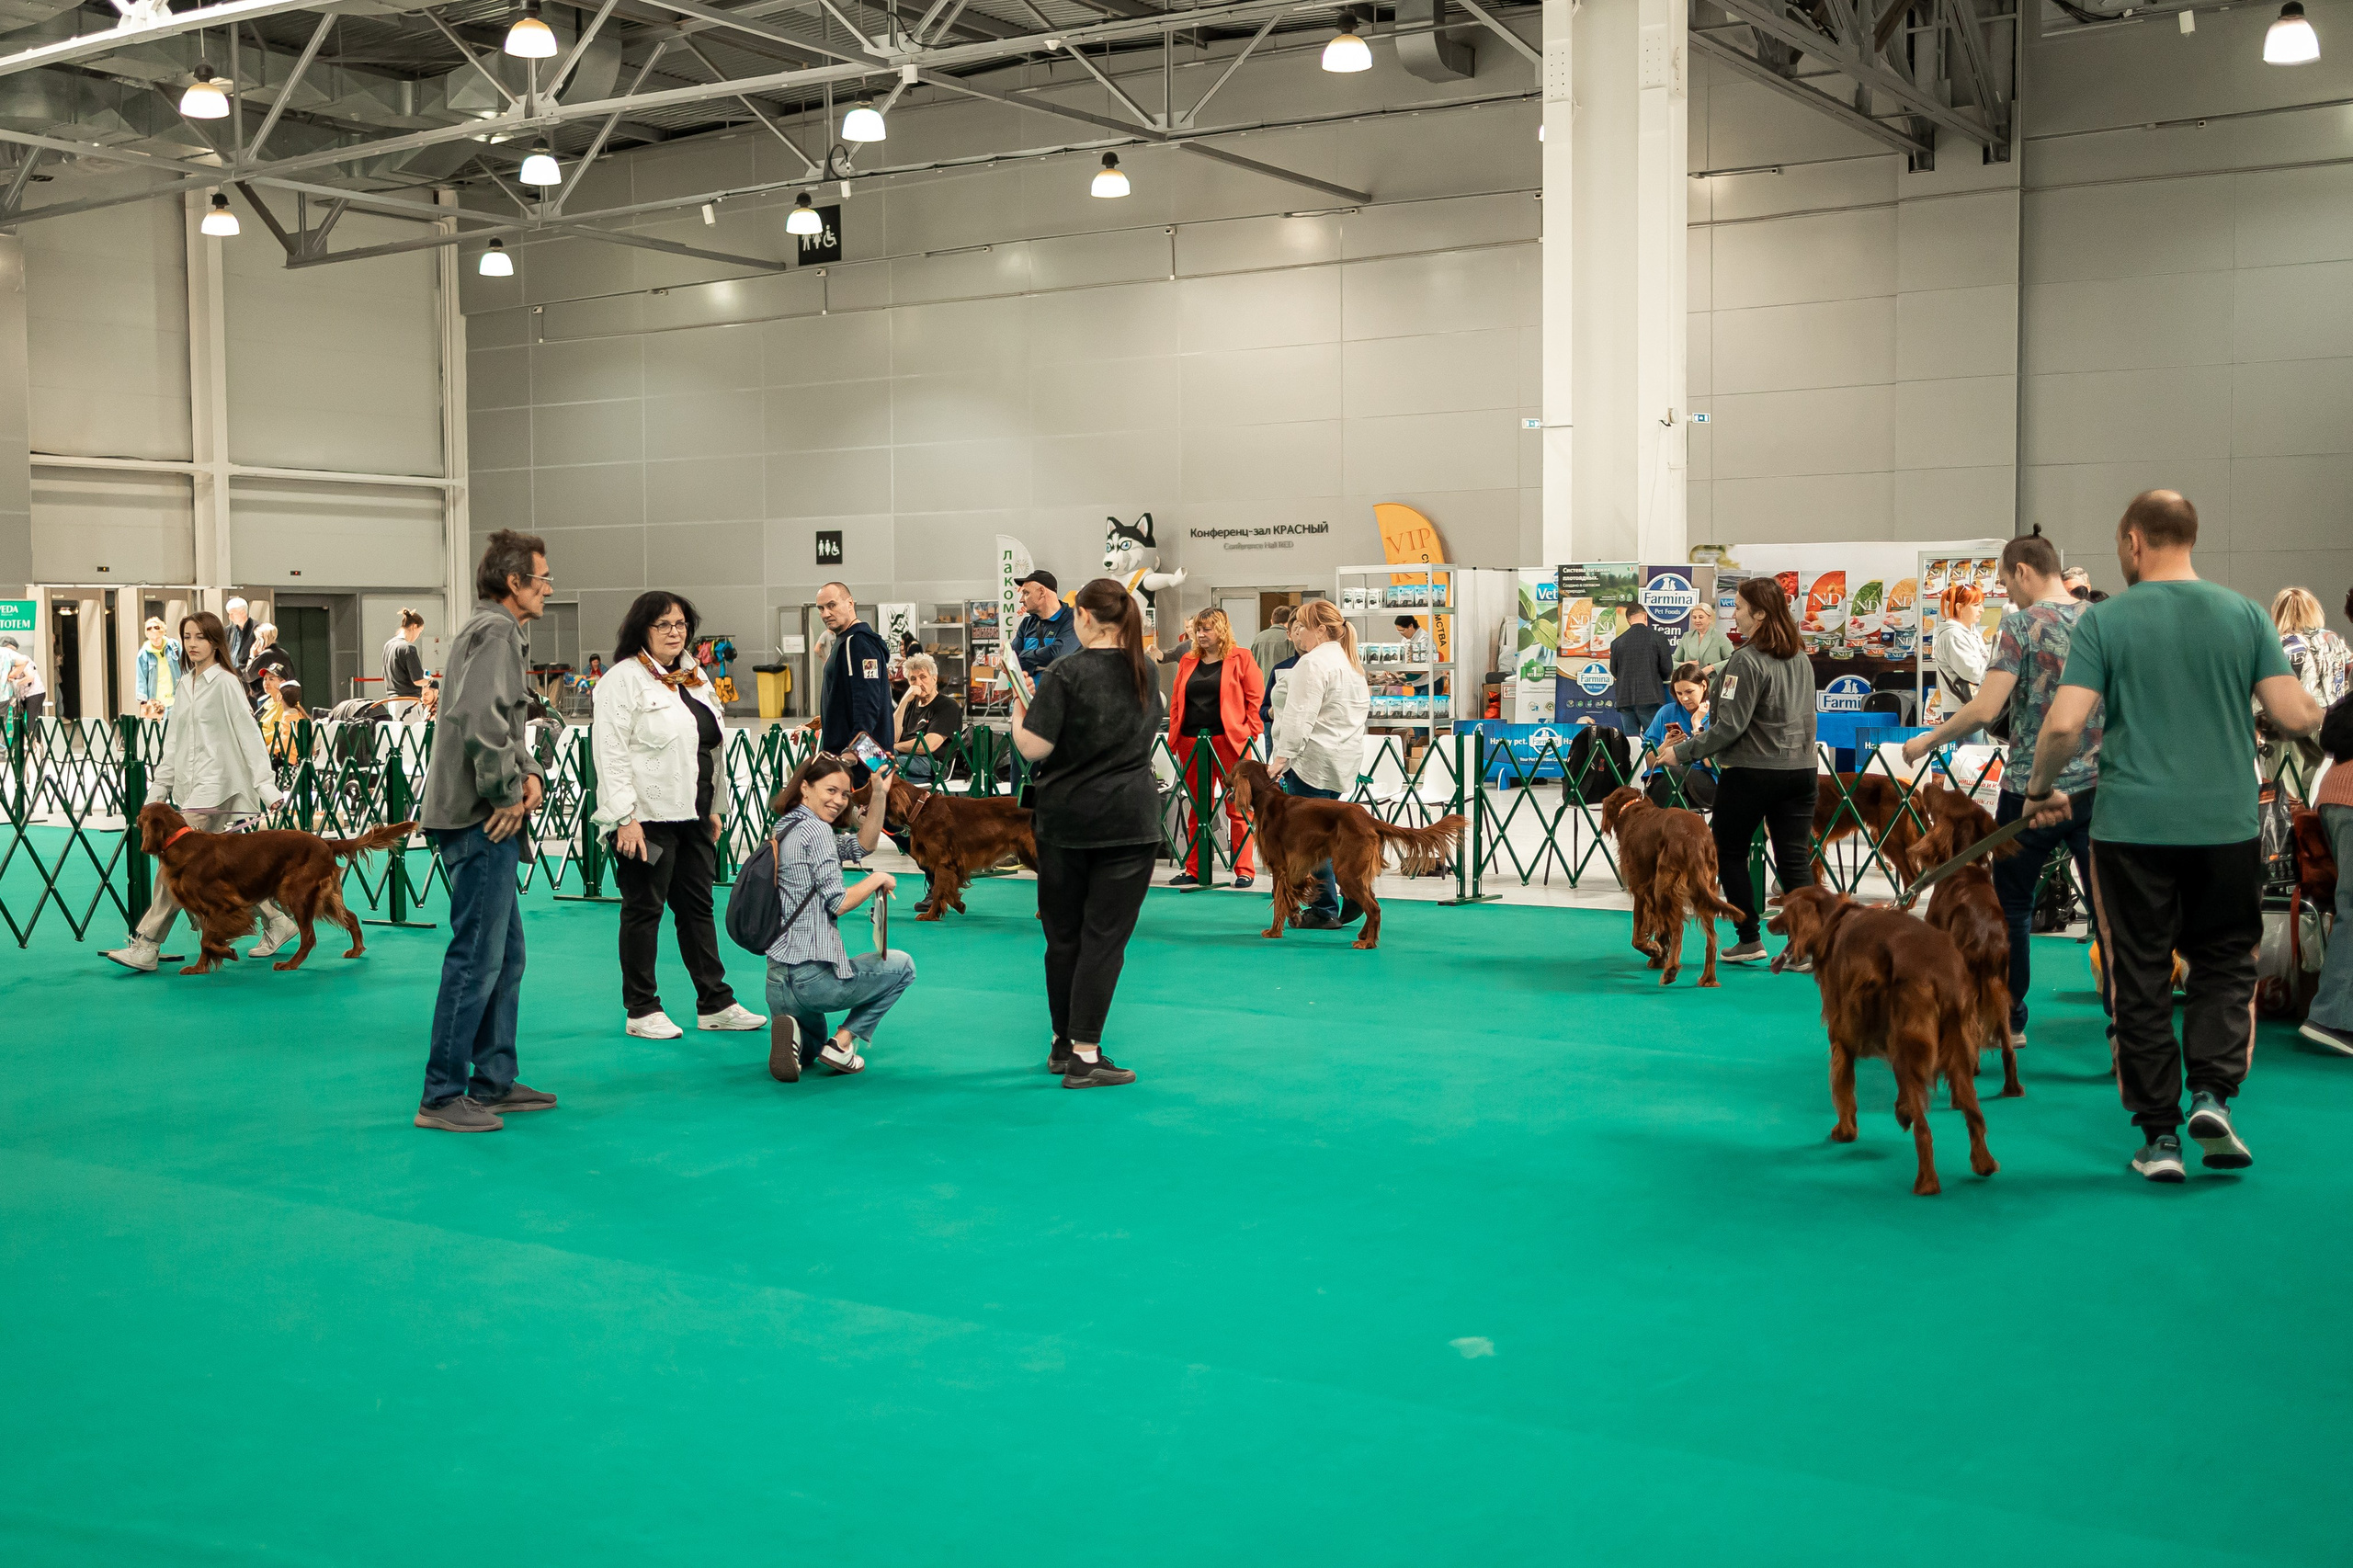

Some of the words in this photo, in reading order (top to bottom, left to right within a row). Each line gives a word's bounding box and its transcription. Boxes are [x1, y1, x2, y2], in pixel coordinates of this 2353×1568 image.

[1190, 528, 1271, 540] Конференц-зал
[1273, 521, 1329, 535] КРАСНЫЙ
[1223, 542, 1263, 551] Conference
[1386, 528, 1431, 554] VIP
[1003, 550, 1015, 640] лакомст
[1644, 592, 1693, 605] Farmina
[0, 605, 19, 614] EDA
[1434, 614, 1448, 648] МСТВА
[1652, 623, 1682, 636] Team
[1581, 674, 1610, 683] Farmina
[1824, 695, 1861, 709] Farmi
[1490, 737, 1512, 746] Hay
[1532, 737, 1559, 745] Farma
